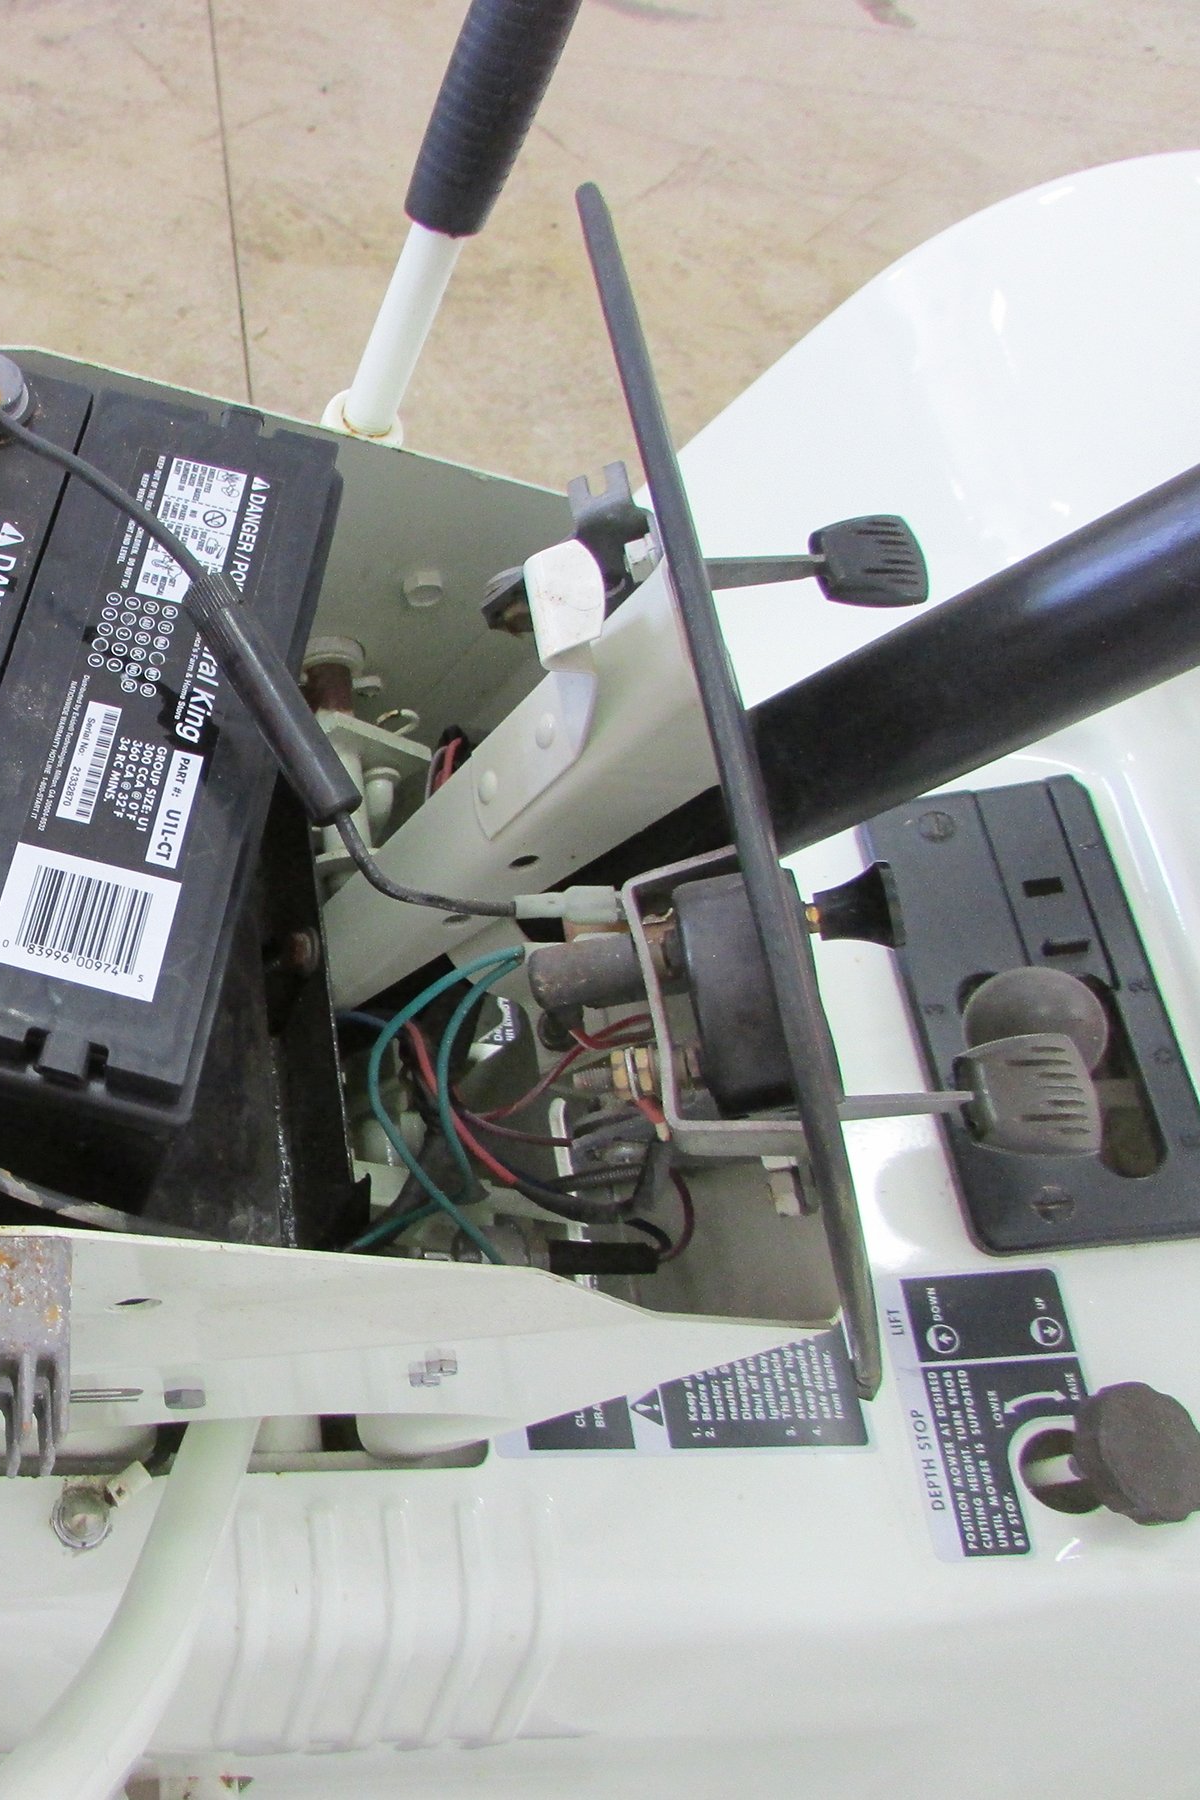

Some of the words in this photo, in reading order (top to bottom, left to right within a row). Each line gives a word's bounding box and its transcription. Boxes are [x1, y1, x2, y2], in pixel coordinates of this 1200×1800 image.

[233, 492, 265, 553] DANGER
[187, 652, 197, 672] Farm
[179, 678, 190, 700] Home
[173, 699, 186, 721] Store
[173, 684, 215, 745] King
[82, 717, 95, 740] Serial
[77, 741, 88, 757] No:
[117, 736, 131, 752] 34
[127, 739, 143, 762] 360
[139, 742, 155, 765] 300
[112, 753, 126, 769] RC
[122, 763, 136, 779] CA
[147, 745, 168, 786] GROUP
[174, 756, 190, 784] PART
[62, 765, 81, 807] 21332870
[102, 769, 121, 803] MINS.
[119, 780, 132, 791] @
[133, 766, 149, 789] CCA
[171, 786, 181, 797] #:
[130, 790, 143, 800] @
[140, 787, 156, 814] SIZE:
[135, 816, 149, 832] U1
[154, 807, 182, 861] U1L-CT
[1, 938, 9, 948] 0
[26, 942, 70, 964] 83996
[75, 955, 120, 977] 00974
[137, 974, 144, 982] 5
[926, 1287, 942, 1321] DOWN
[1034, 1297, 1045, 1309] UP
[886, 1308, 905, 1335] LIFT
[927, 1370, 946, 1416] DESIRED
[942, 1370, 958, 1404] KNOB
[1064, 1371, 1079, 1400] RAISE
[956, 1369, 980, 1434] SUPPORTED
[986, 1389, 1004, 1428] LOWER
[908, 1408, 931, 1450] STOP
[939, 1421, 951, 1436] AT
[951, 1410, 966, 1440] TURN
[974, 1442, 985, 1452] IS
[943, 1441, 963, 1487] MOWER
[920, 1458, 946, 1510] DEPTH
[978, 1459, 998, 1505] MOWER
[955, 1492, 978, 1549] POSITION
[972, 1496, 993, 1548] CUTTING
[992, 1513, 1009, 1547] UNTIL
[1012, 1530, 1024, 1546] BY
